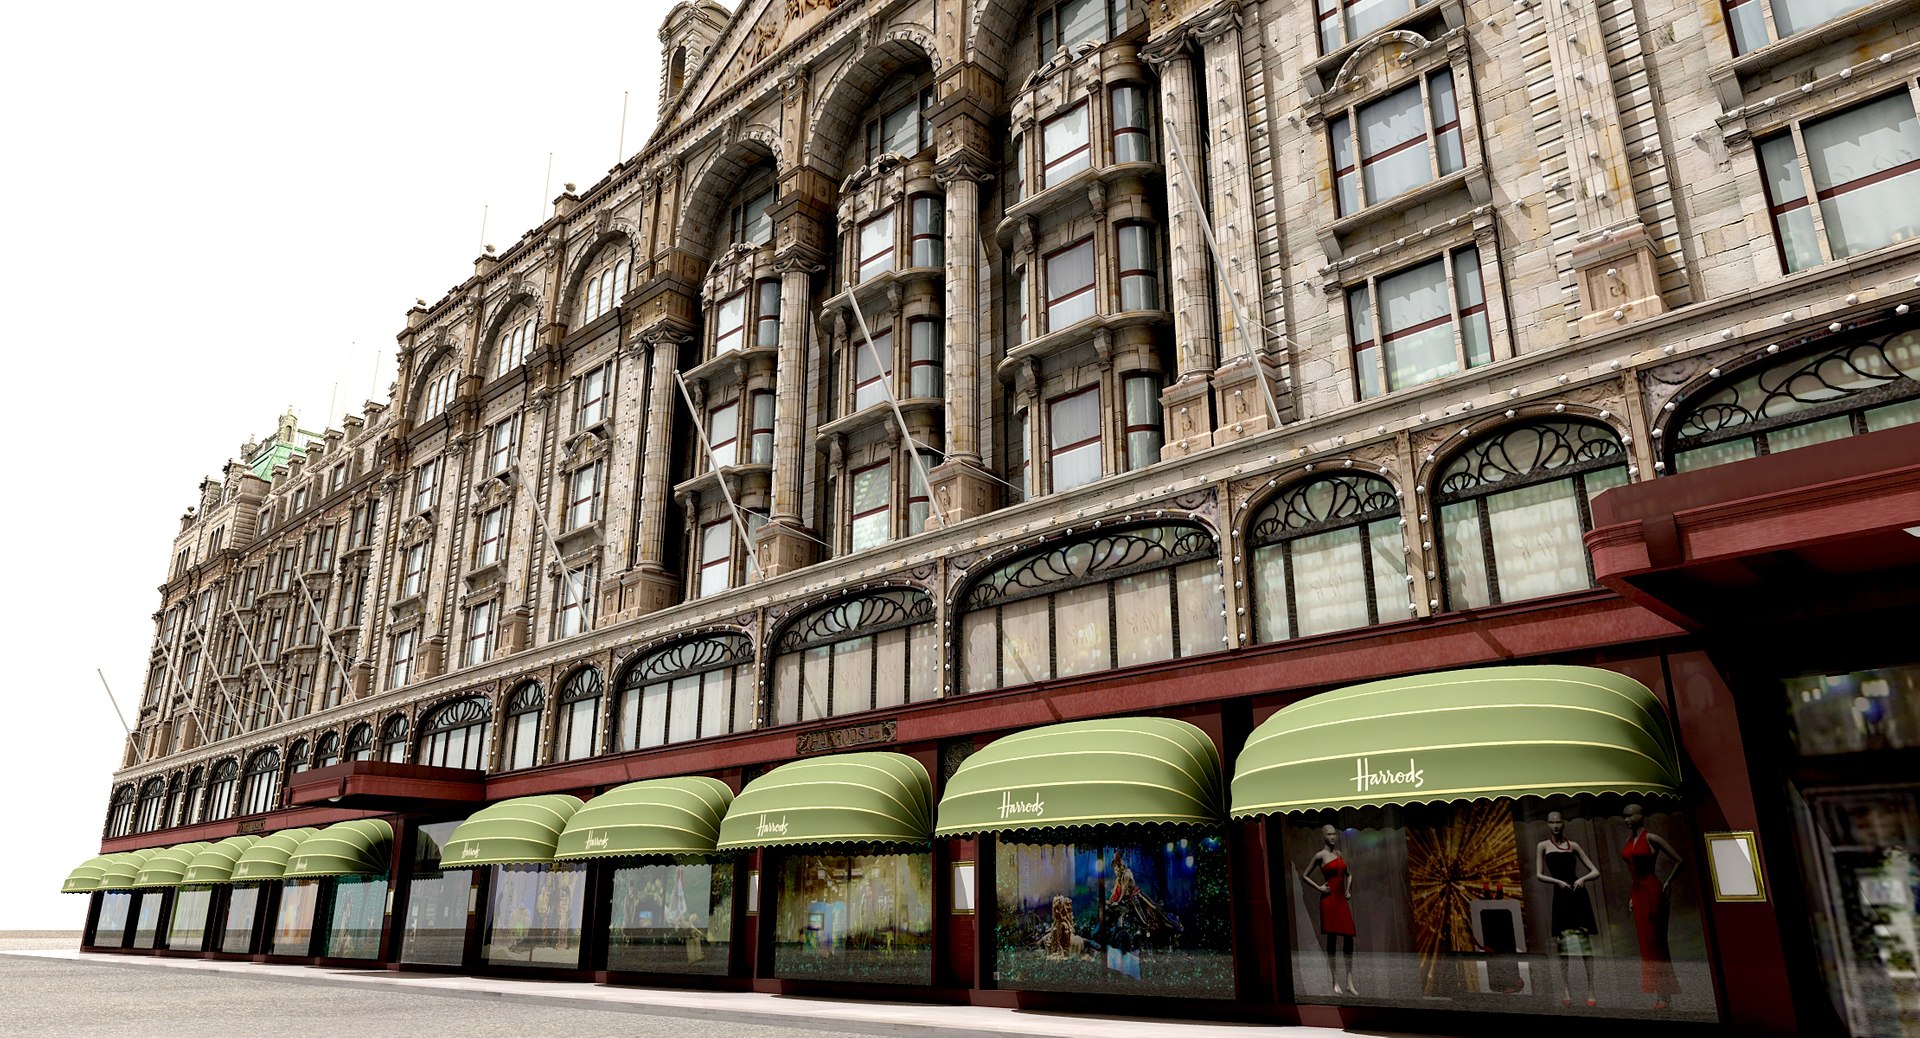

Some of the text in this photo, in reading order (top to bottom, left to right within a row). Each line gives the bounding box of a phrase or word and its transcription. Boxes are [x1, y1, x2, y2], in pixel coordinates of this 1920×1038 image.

[1350, 757, 1424, 792] Harrods
[997, 791, 1044, 819] Harrods
[756, 814, 789, 837] Harrods
